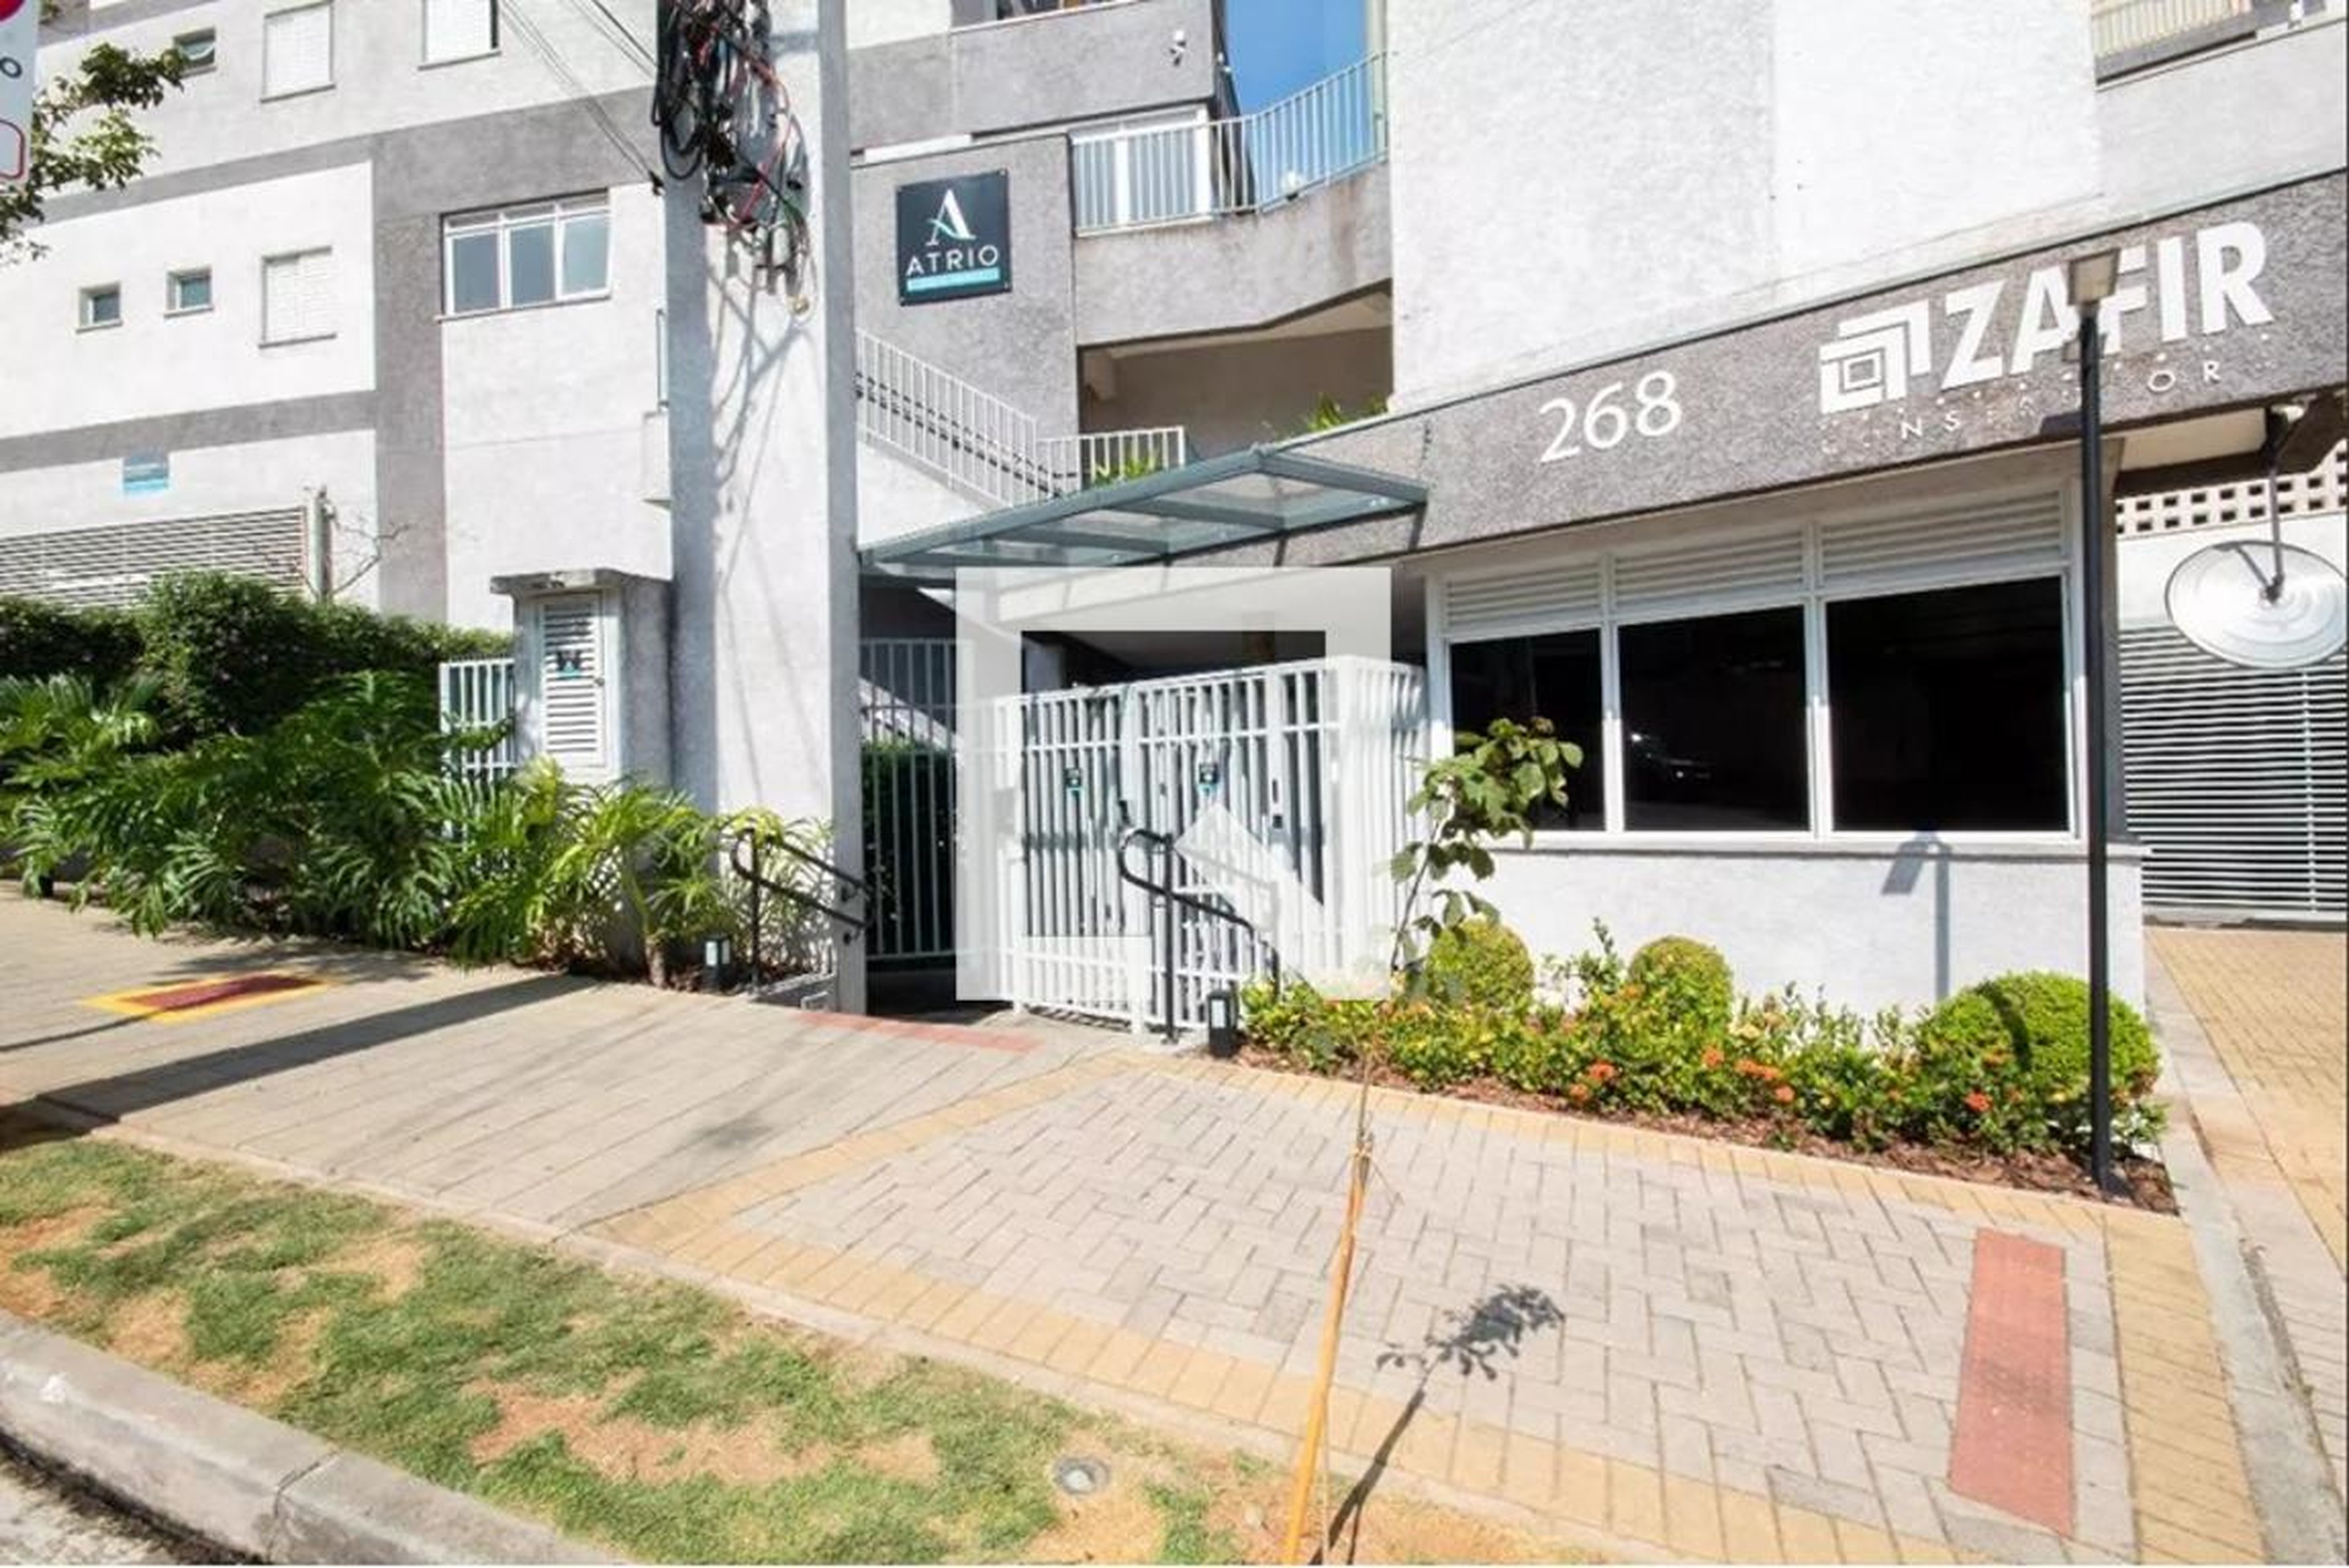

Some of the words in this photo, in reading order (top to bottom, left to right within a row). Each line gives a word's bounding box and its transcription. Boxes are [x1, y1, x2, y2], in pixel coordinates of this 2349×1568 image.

[906, 245, 998, 276] ATRIO
[1940, 221, 2274, 392] ZAFIR
[1539, 370, 1682, 462] 268
